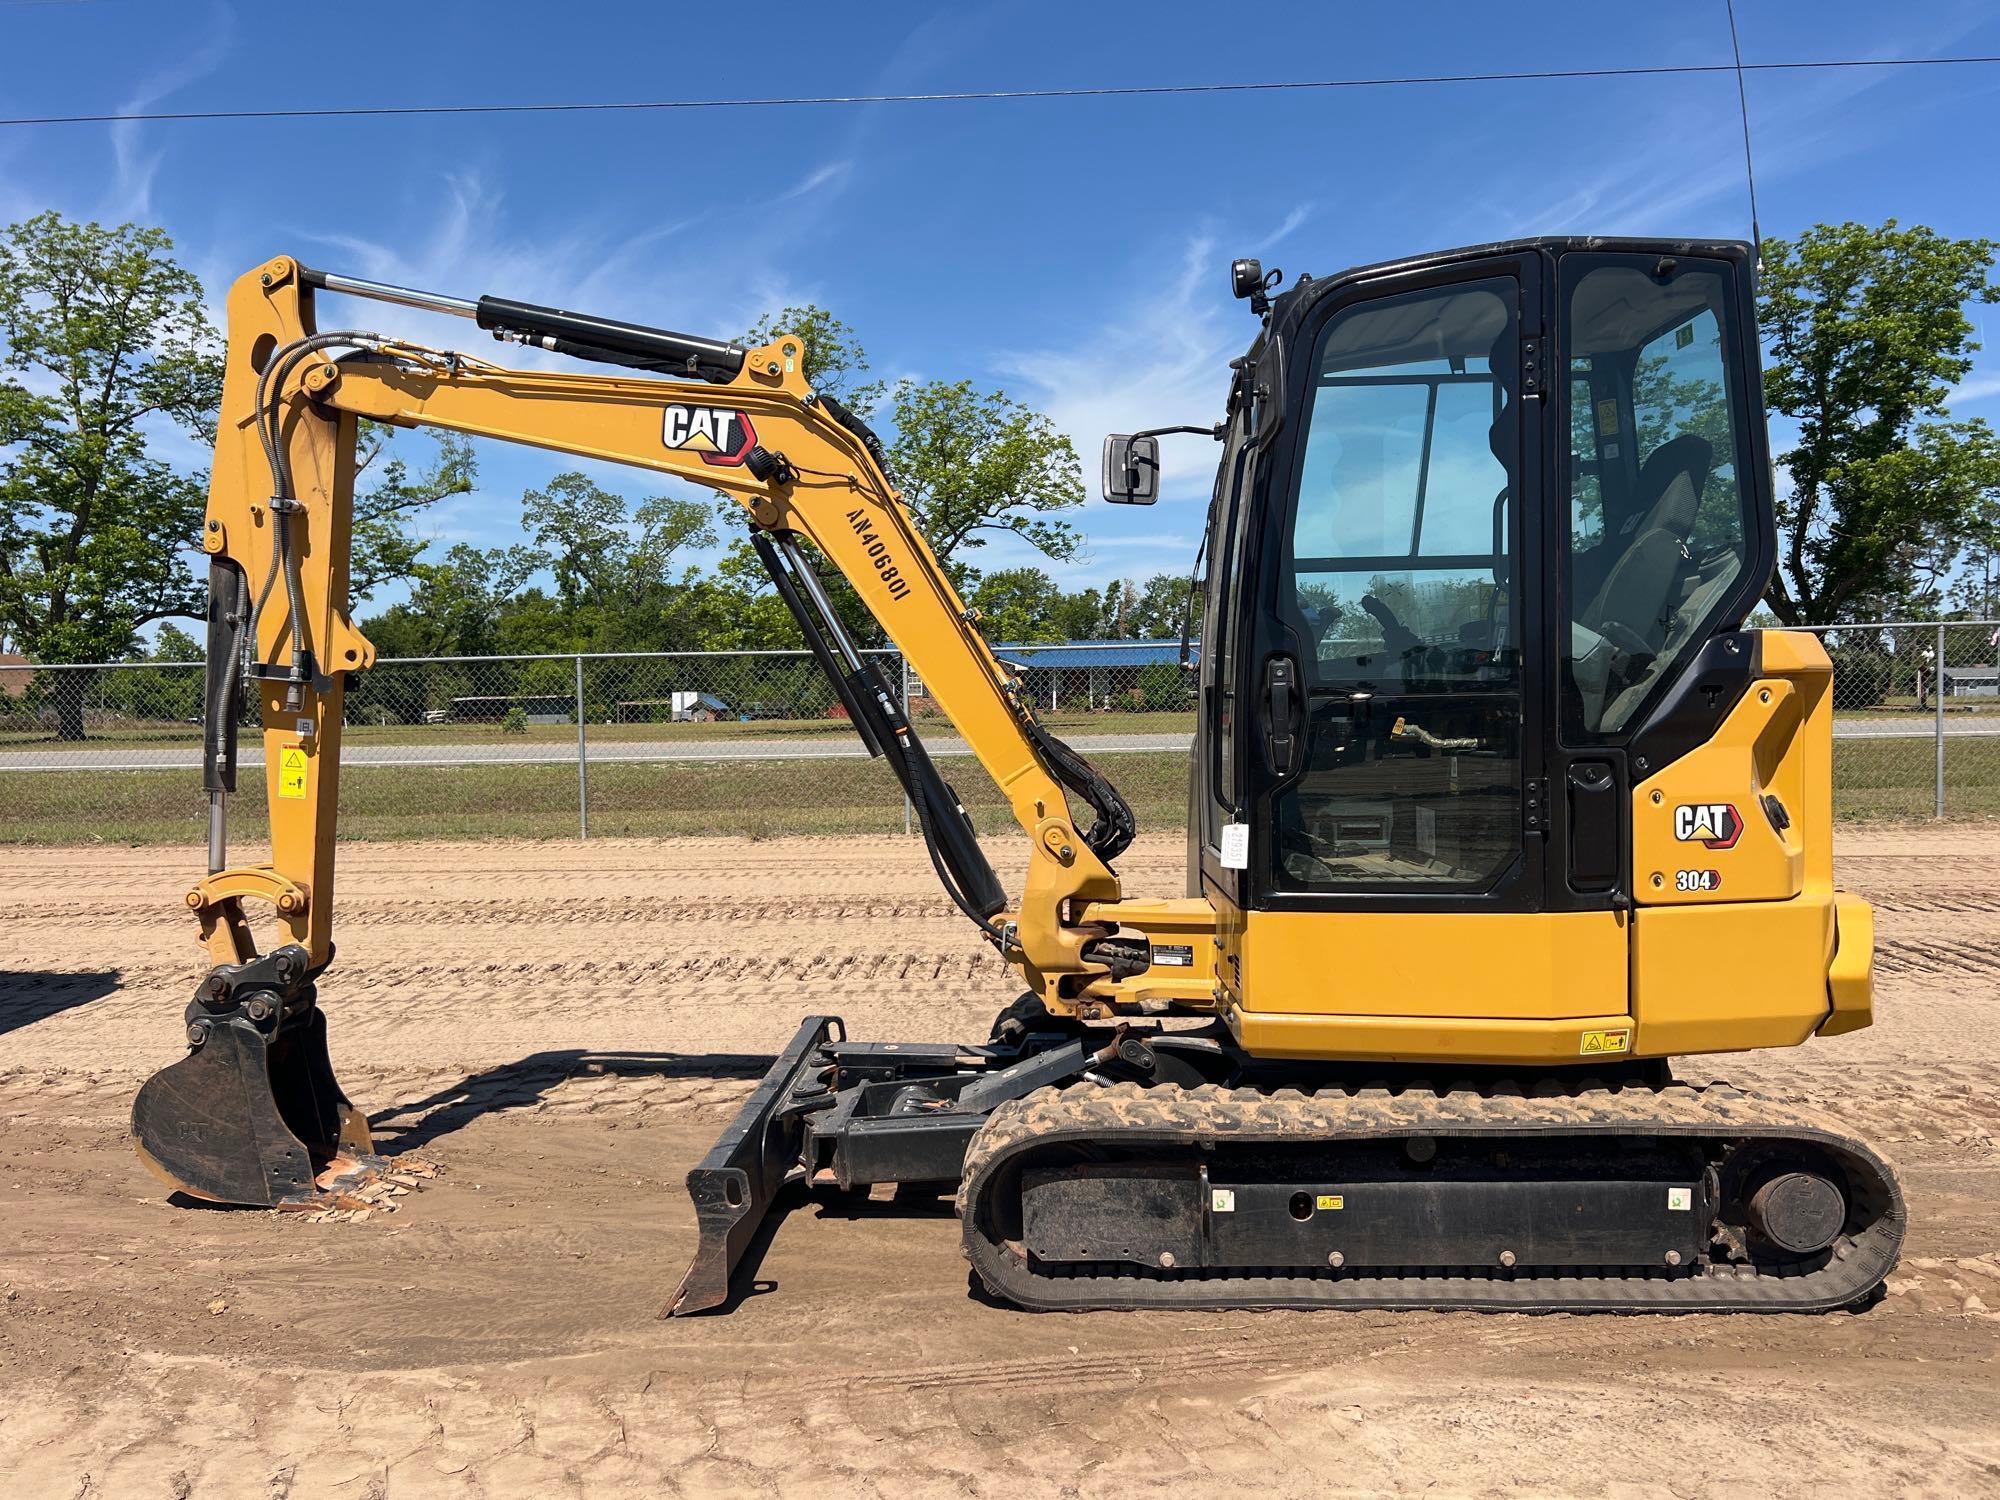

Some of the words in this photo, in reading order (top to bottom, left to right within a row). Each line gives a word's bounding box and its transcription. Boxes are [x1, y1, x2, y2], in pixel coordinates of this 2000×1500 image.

[664, 404, 736, 452] CAT
[1675, 805, 1727, 840] CAT
[1676, 870, 1711, 890] 304
